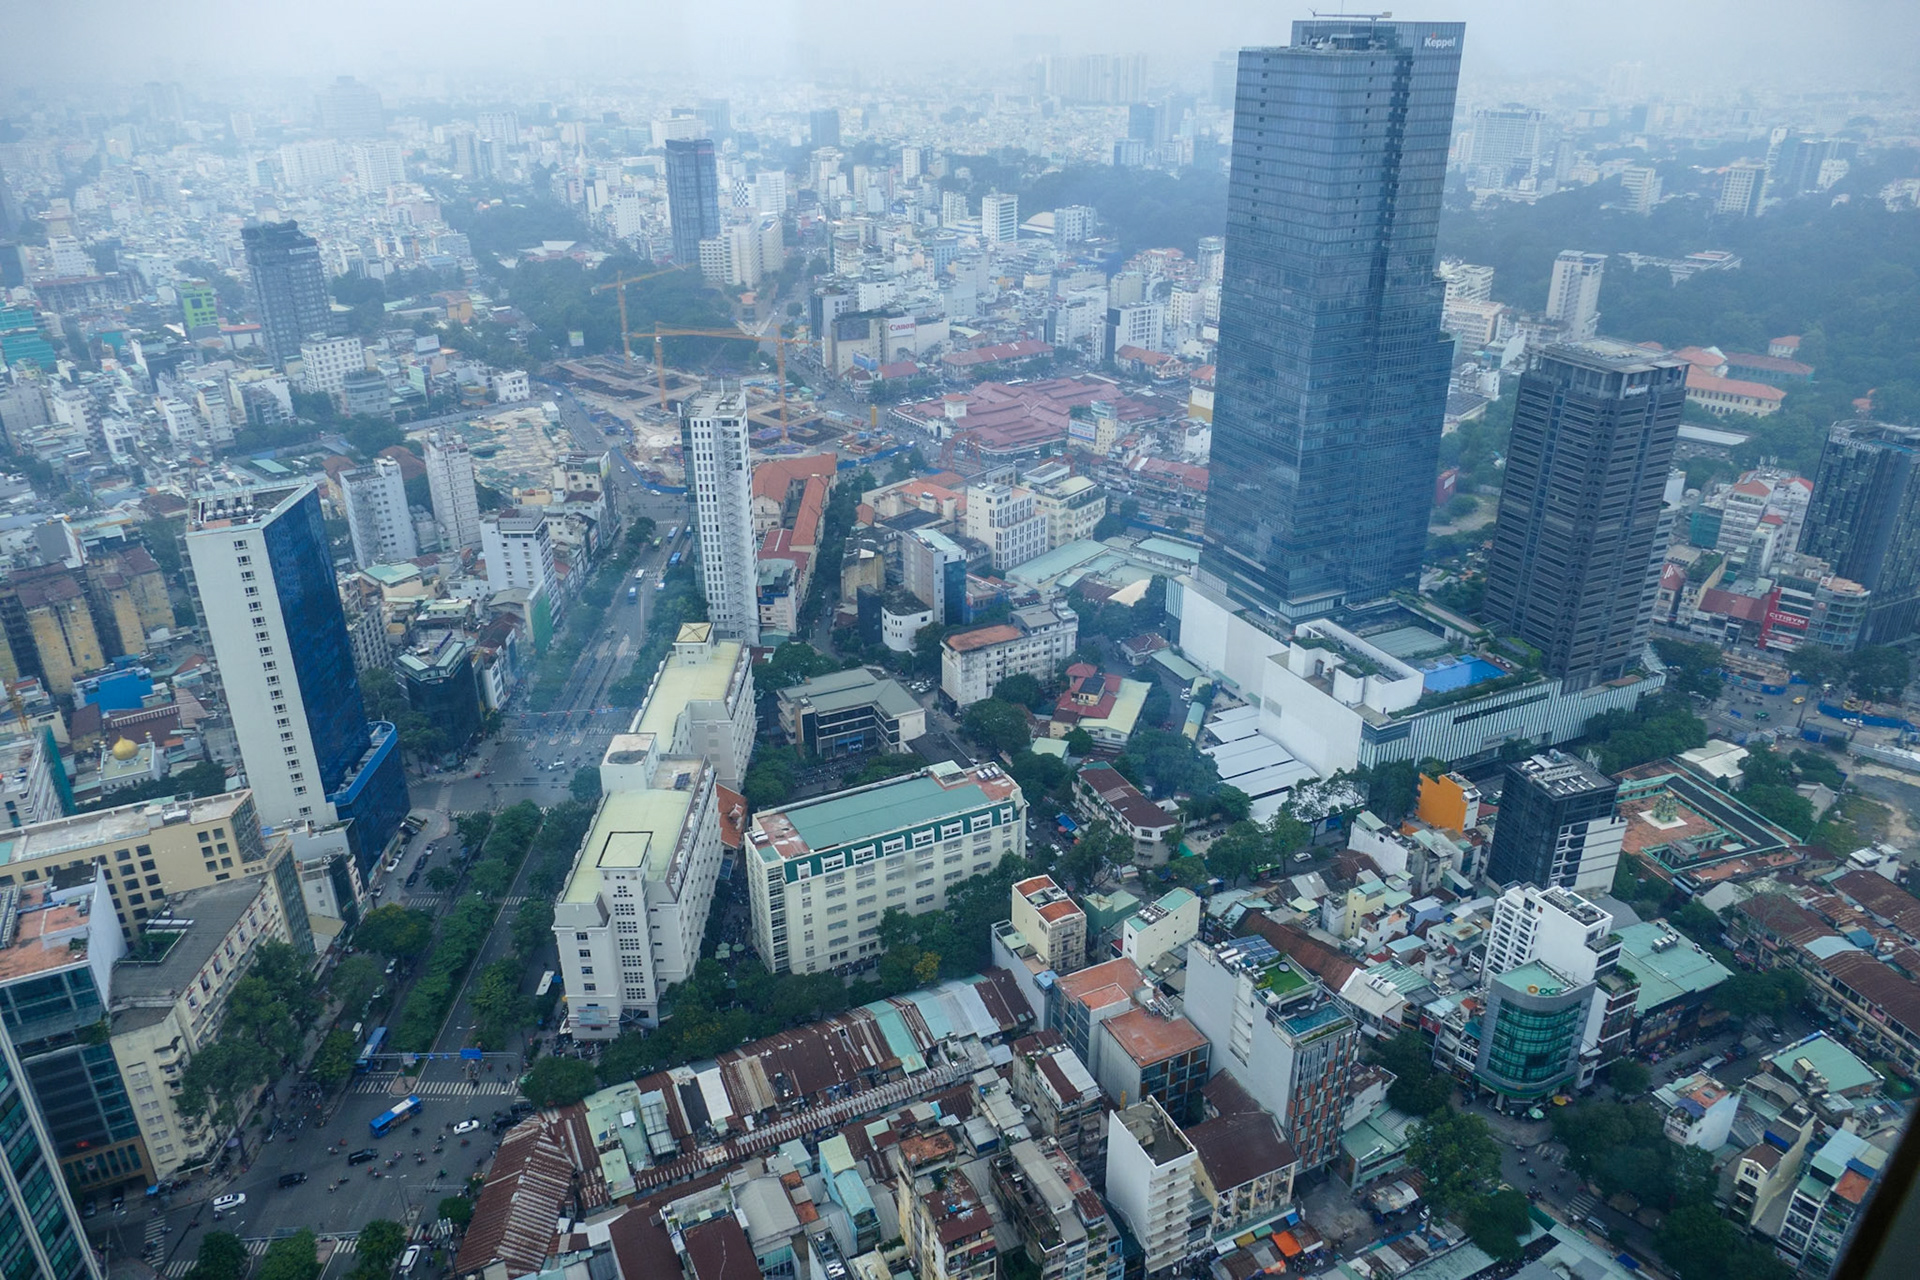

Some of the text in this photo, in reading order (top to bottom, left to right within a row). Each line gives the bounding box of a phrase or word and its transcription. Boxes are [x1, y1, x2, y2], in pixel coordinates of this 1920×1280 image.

[1424, 37, 1456, 49] Keppel
[889, 322, 915, 331] Canon
[1769, 612, 1805, 625] CITIGYM
